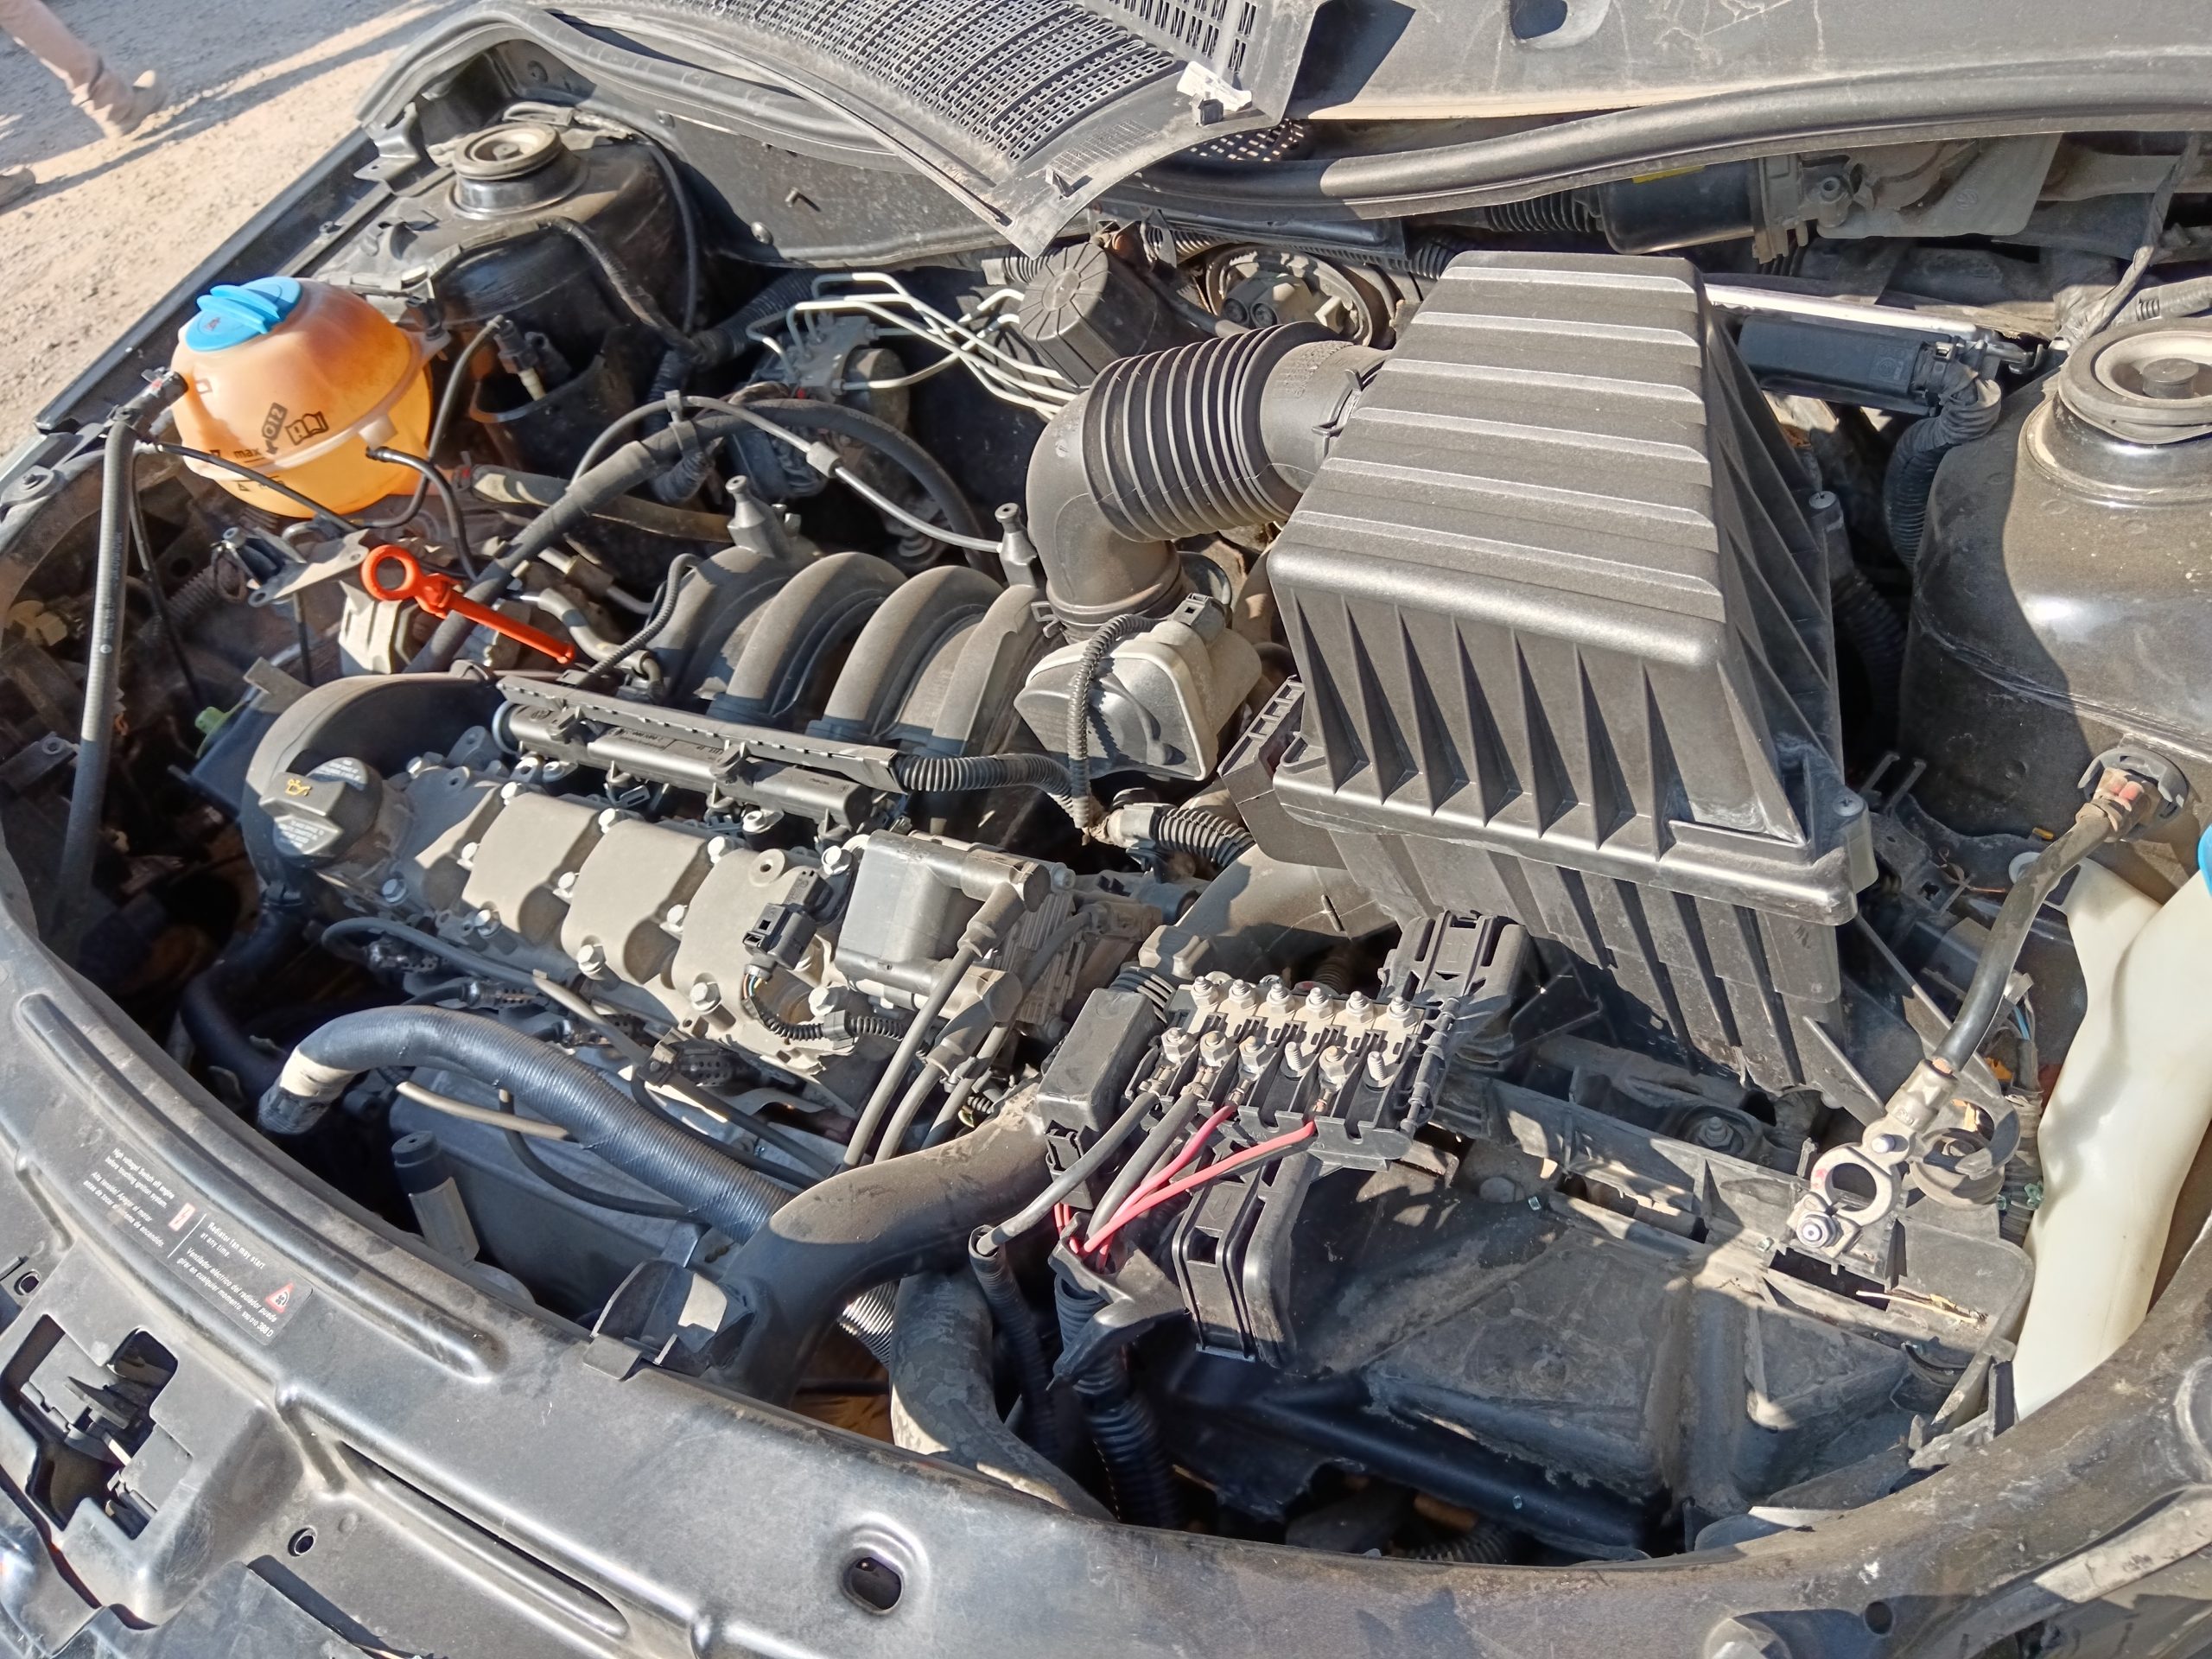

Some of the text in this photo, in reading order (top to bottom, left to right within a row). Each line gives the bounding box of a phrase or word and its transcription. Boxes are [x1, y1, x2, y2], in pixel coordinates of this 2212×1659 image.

[233, 448, 262, 459] max
[83, 1179, 97, 1192] antes
[100, 1193, 114, 1205] tocar
[105, 1155, 119, 1170] before
[118, 1166, 137, 1185] touching
[135, 1180, 151, 1195] ignition
[112, 1147, 124, 1159] High
[138, 1167, 154, 1183] Switch
[159, 1185, 175, 1199] engine
[91, 1172, 102, 1182] Alta
[117, 1192, 134, 1207] Apagar
[137, 1209, 153, 1223] motor
[207, 1222, 266, 1270] Radiator fan may start
[207, 1237, 218, 1249] any
[216, 1243, 231, 1258] time.
[176, 1257, 243, 1312] girar en cualquier momento.
[187, 1247, 277, 1323] Ventilador eléctrico del radiador puede
